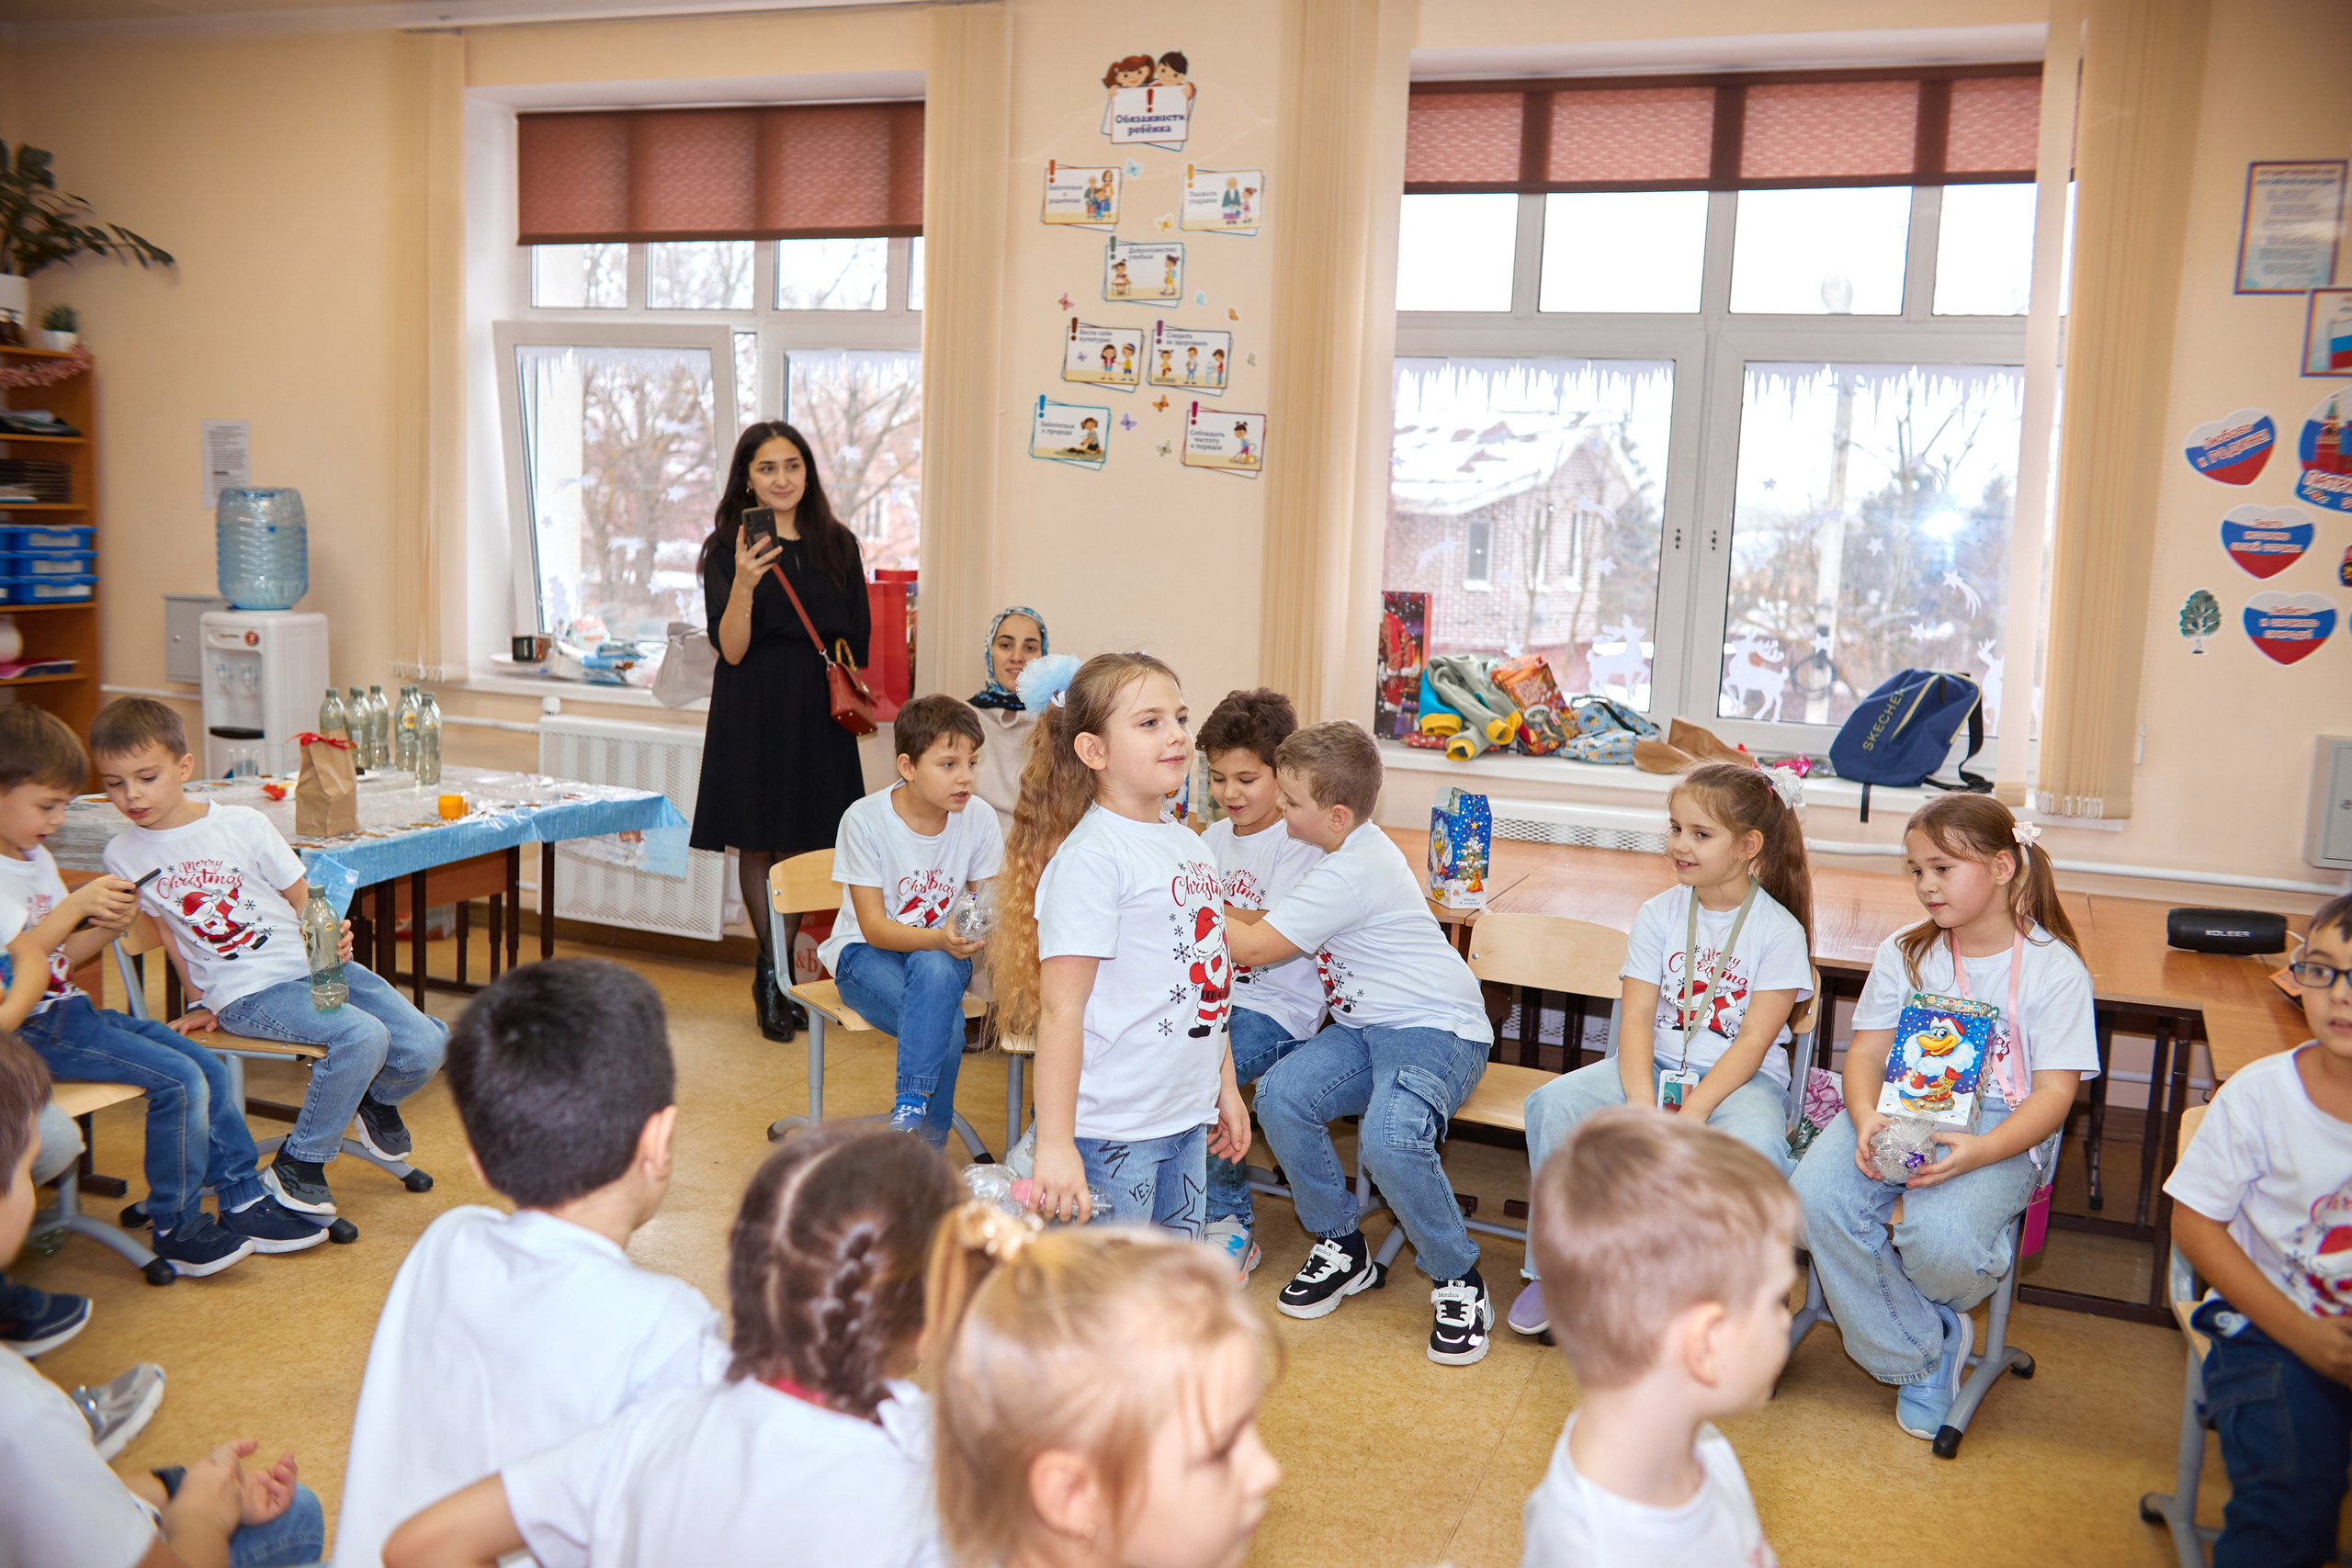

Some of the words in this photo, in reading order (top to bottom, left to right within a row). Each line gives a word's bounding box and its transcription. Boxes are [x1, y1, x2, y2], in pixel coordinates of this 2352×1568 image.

[1862, 689, 1904, 751] SKECHE
[178, 859, 223, 874] Merry
[156, 868, 243, 899] Christmas
[1171, 874, 1223, 907] Christm
[1128, 1179, 1150, 1202] YES
